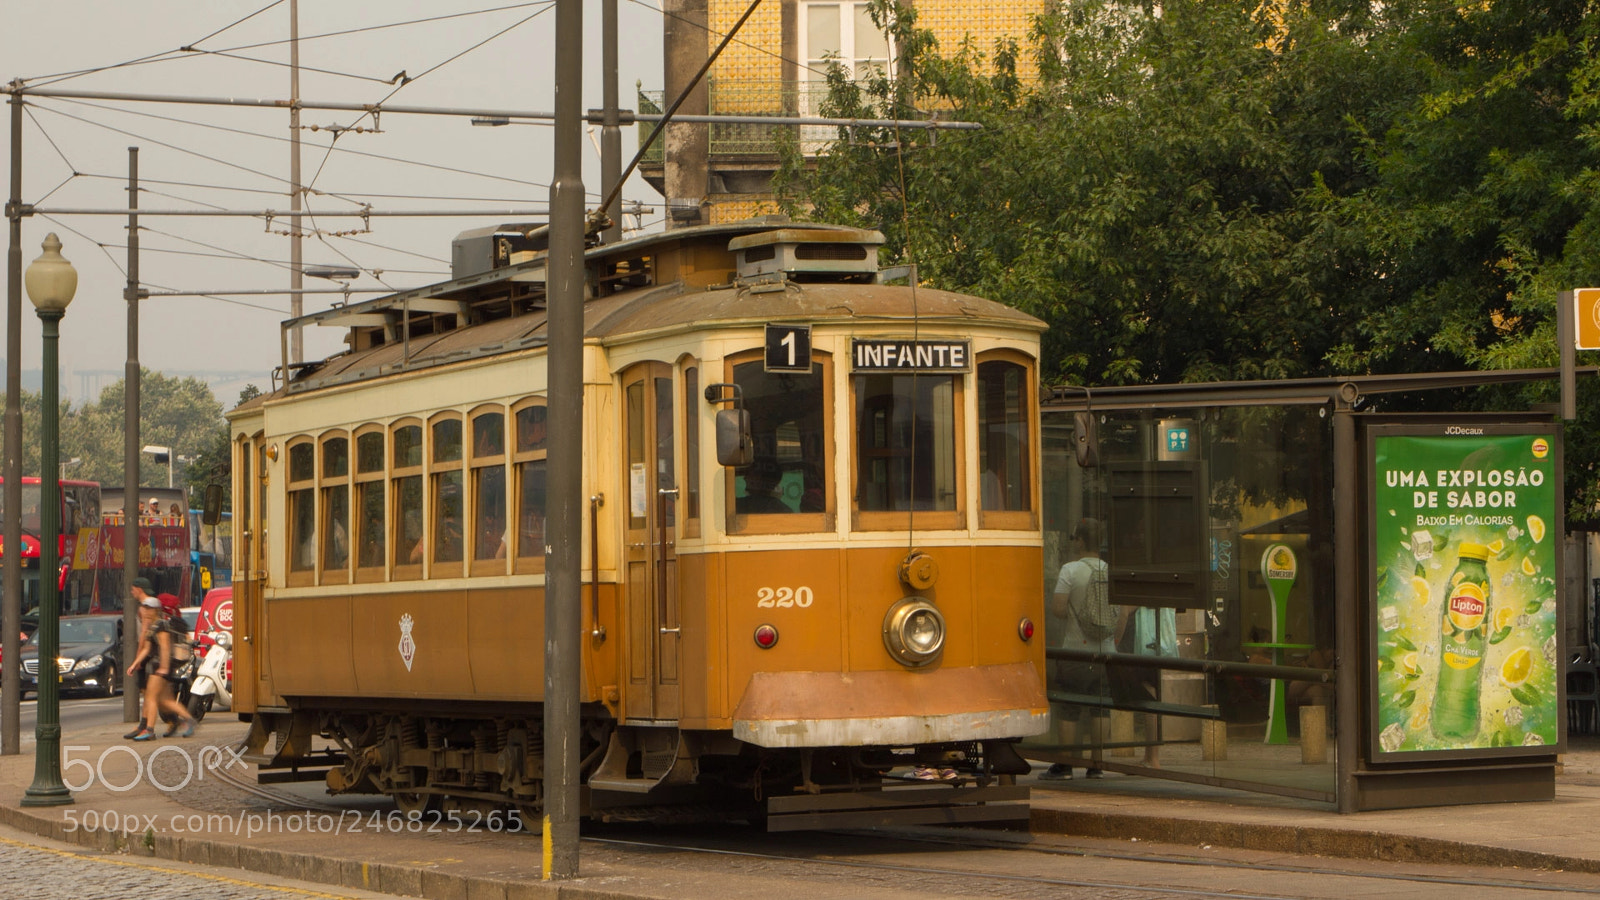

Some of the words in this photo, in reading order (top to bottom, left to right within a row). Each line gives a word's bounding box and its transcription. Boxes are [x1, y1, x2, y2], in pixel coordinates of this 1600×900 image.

[780, 331, 796, 366] 1
[857, 344, 964, 367] INFANTE
[1444, 426, 1484, 435] JCDecaux
[1386, 470, 1429, 488] UMA
[1437, 467, 1544, 487] EXPLOSÃO
[1413, 492, 1438, 508] DE
[1447, 491, 1517, 508] SABOR
[757, 586, 813, 608] 220
[1453, 599, 1482, 612] Lipton
